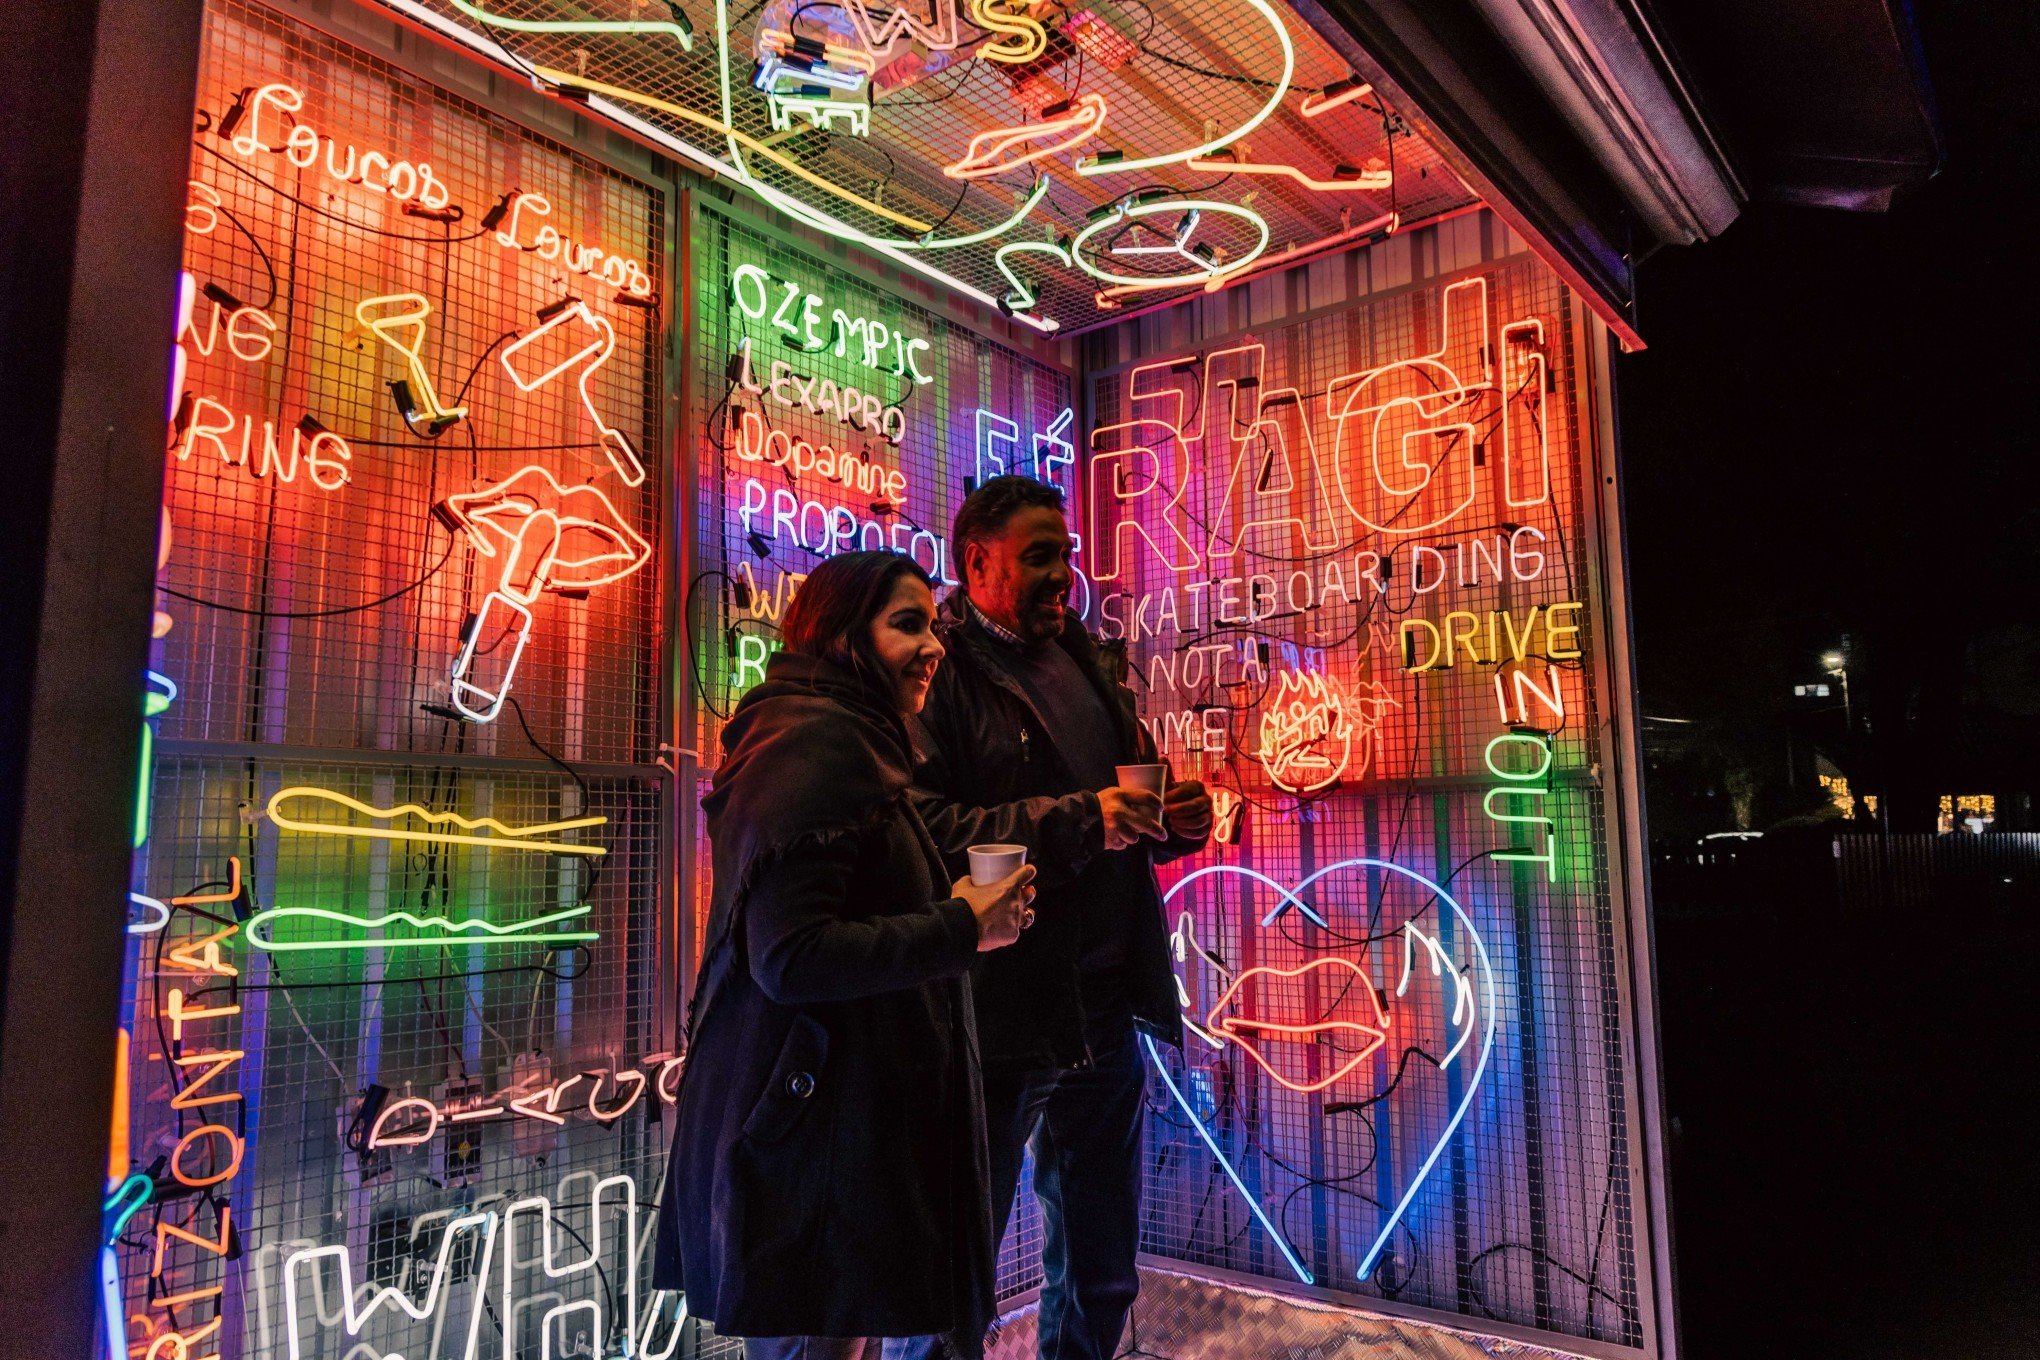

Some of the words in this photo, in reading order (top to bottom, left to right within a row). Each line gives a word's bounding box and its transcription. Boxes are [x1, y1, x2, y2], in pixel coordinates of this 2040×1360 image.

[733, 263, 934, 385] OZEMPIC
[737, 337, 906, 443] LEXAPRO
[735, 411, 908, 504] Dopamine
[1399, 601, 1583, 674] DRIVE
[1494, 664, 1565, 725] IN
[1484, 734, 1556, 883] OUT
